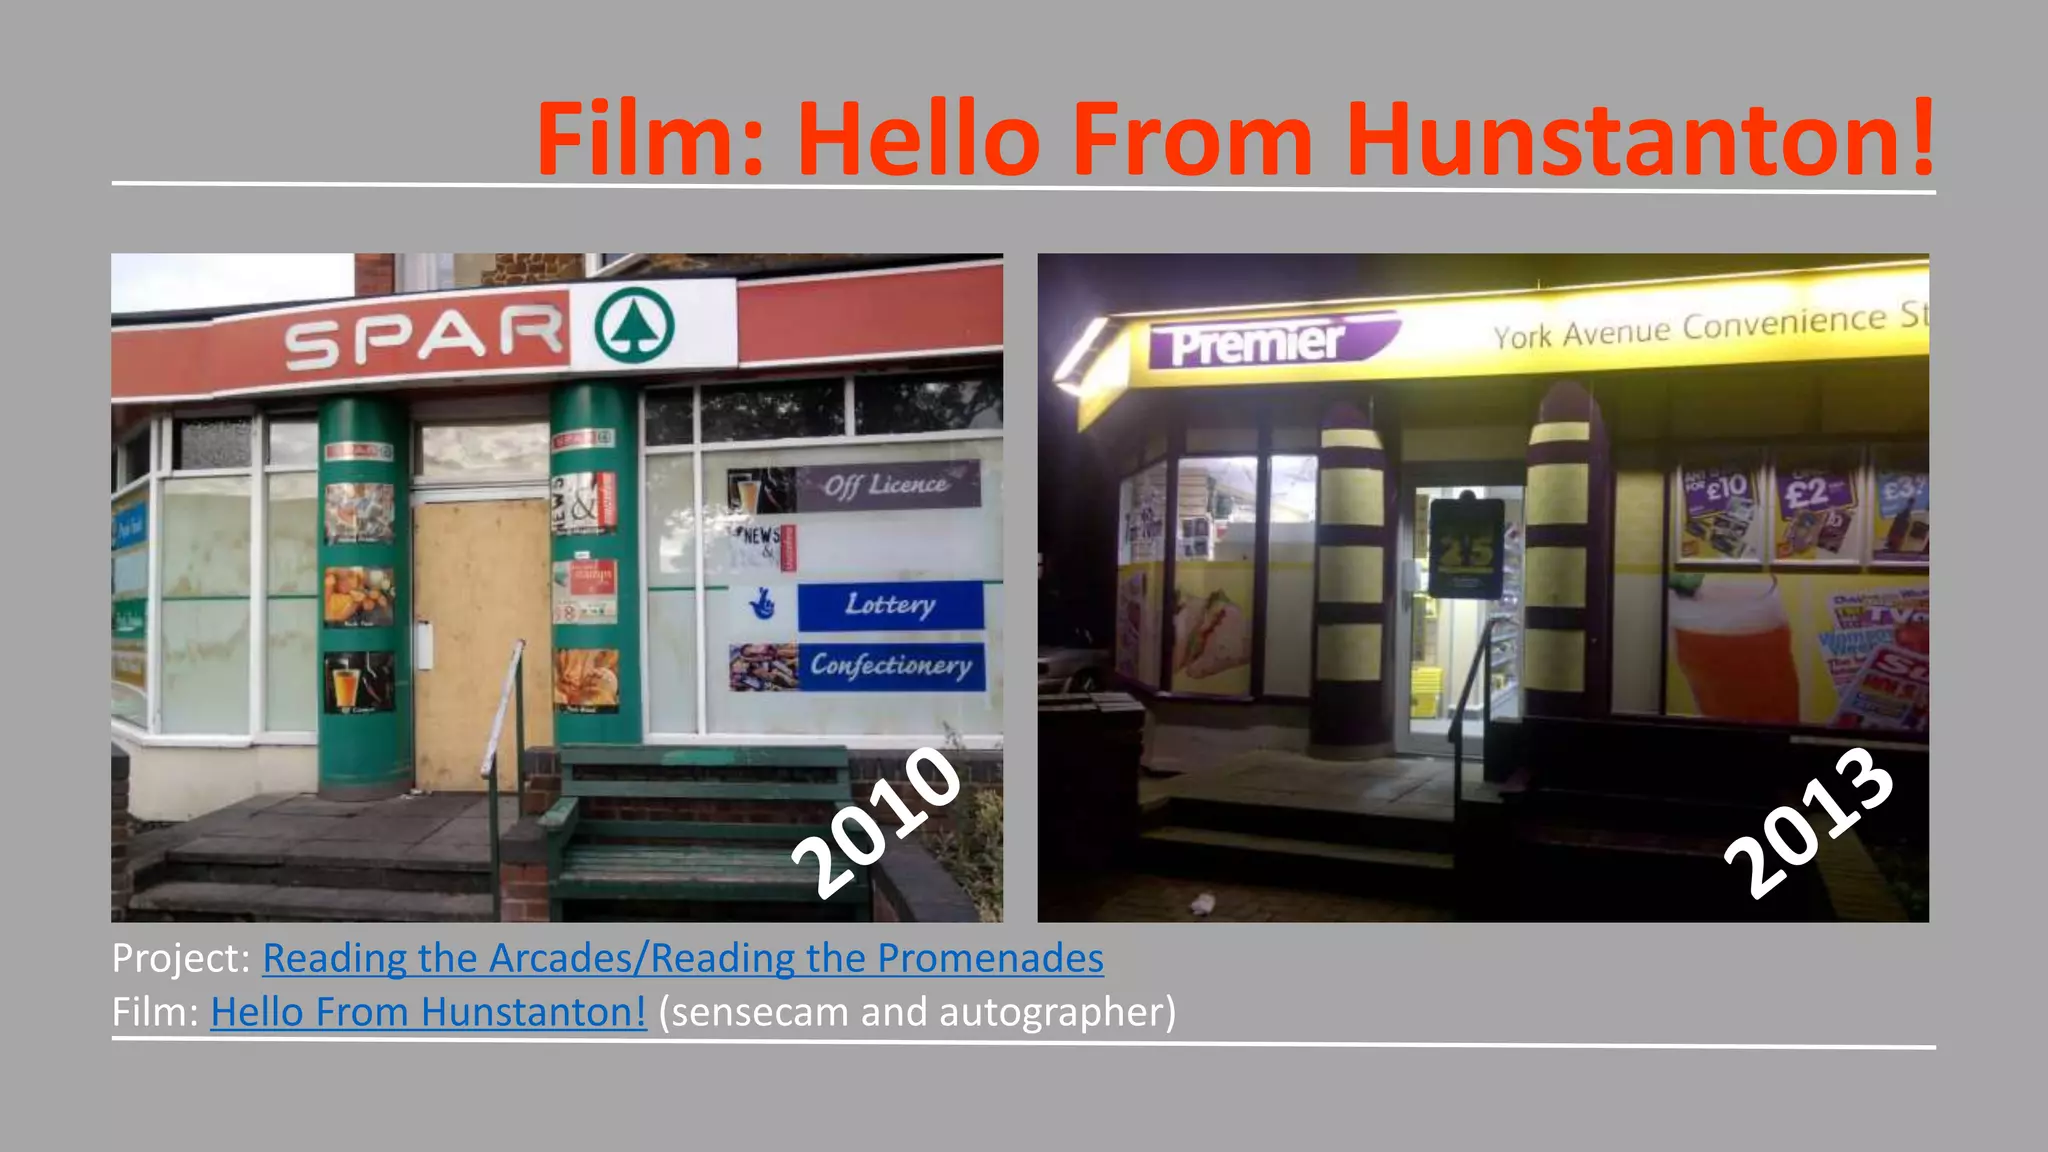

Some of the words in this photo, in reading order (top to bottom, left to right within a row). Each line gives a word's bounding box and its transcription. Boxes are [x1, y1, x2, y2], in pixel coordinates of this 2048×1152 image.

[284, 303, 564, 371] SPAR
[1494, 323, 1552, 351] York
[1563, 321, 1671, 347] Avenue
[1683, 308, 1888, 340] Convenience
[1171, 325, 1347, 368] Premier
[824, 472, 865, 502] Off
[867, 472, 948, 496] Licence
[1706, 473, 1748, 501] £10
[1784, 477, 1829, 509] £2
[743, 526, 781, 545] NEWS
[845, 592, 936, 621] Lottery
[810, 652, 973, 682] Confectionery
